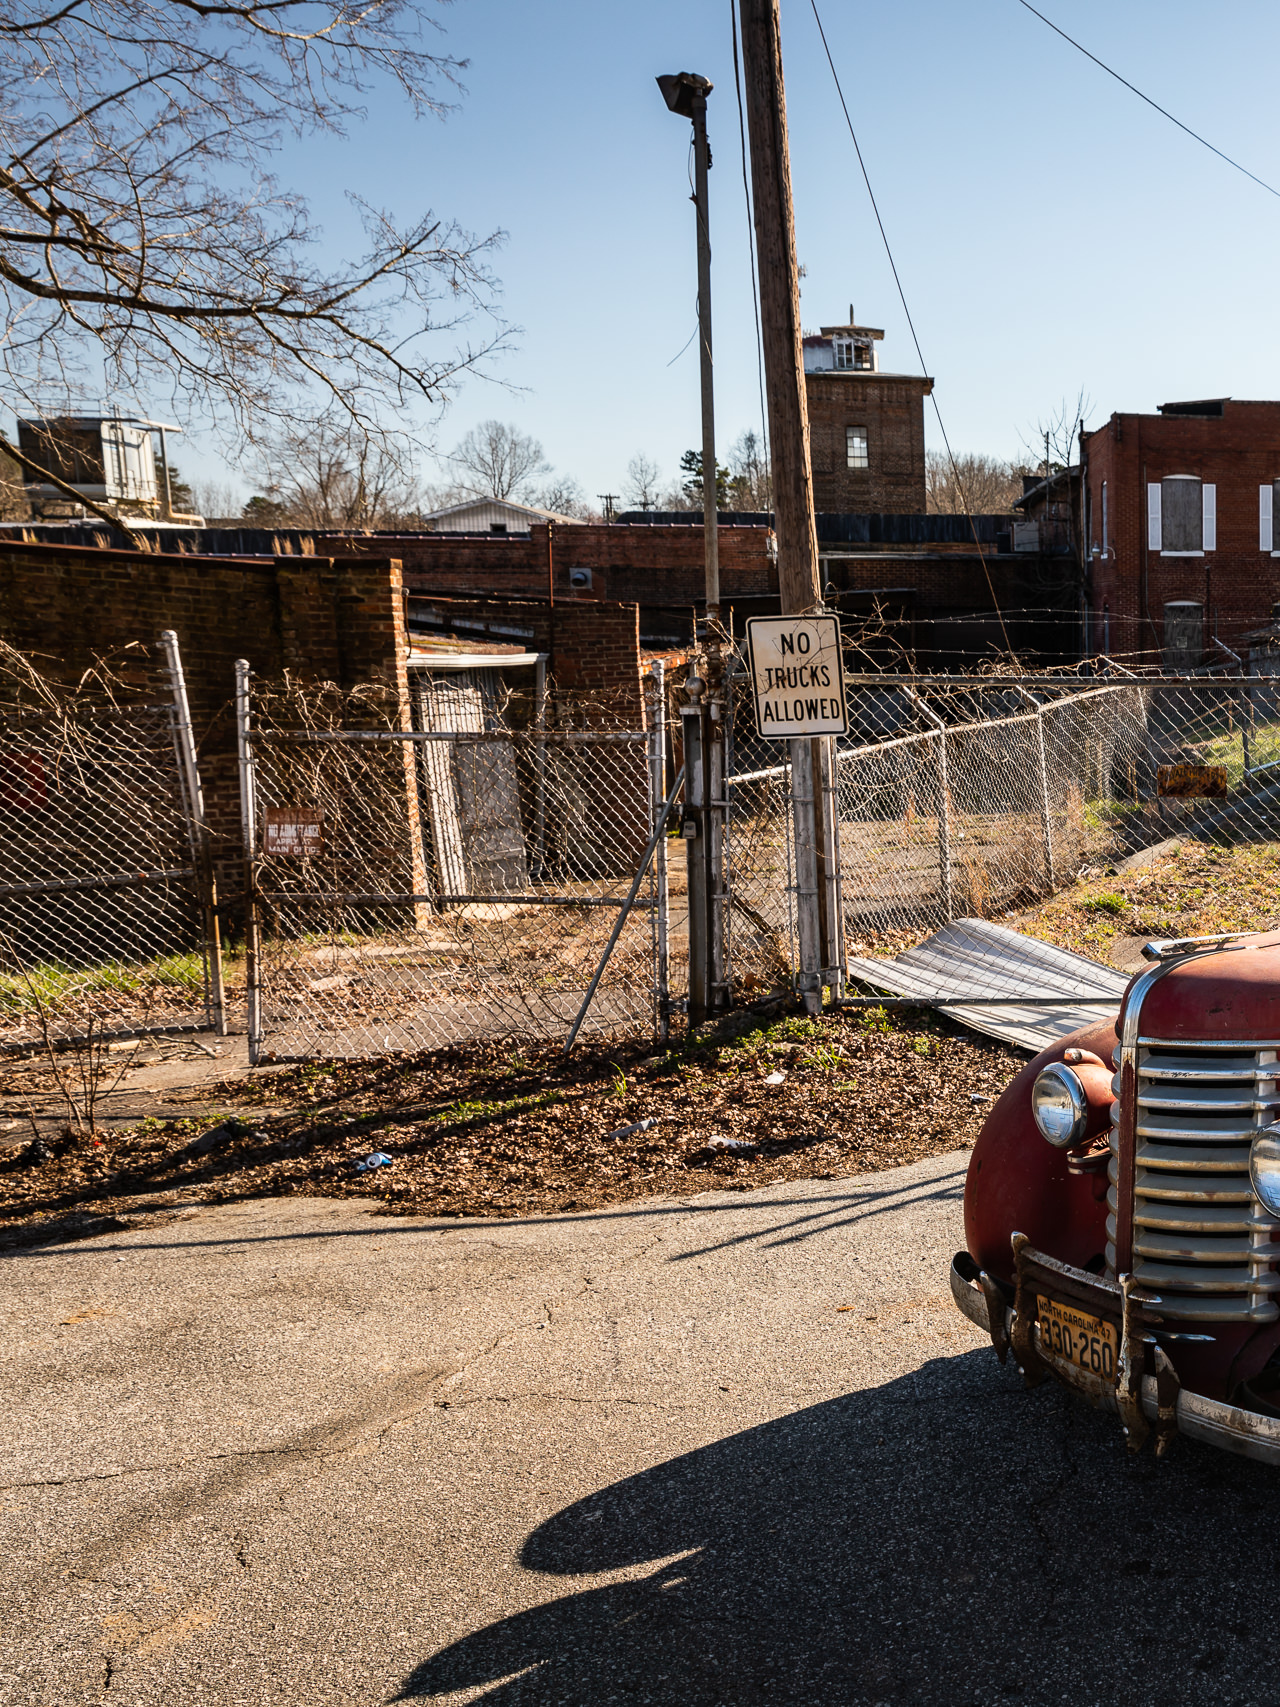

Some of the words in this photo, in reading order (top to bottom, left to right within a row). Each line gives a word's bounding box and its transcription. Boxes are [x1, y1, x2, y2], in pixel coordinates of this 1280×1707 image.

[780, 632, 811, 655] NO
[765, 665, 831, 689] TRUCKS
[763, 698, 840, 722] ALLOWED
[268, 824, 279, 837] NO
[1039, 1300, 1062, 1320] NORTH
[1063, 1311, 1099, 1336] CAROLINA
[1101, 1327, 1111, 1340] 47
[1041, 1314, 1113, 1379] 330-260
